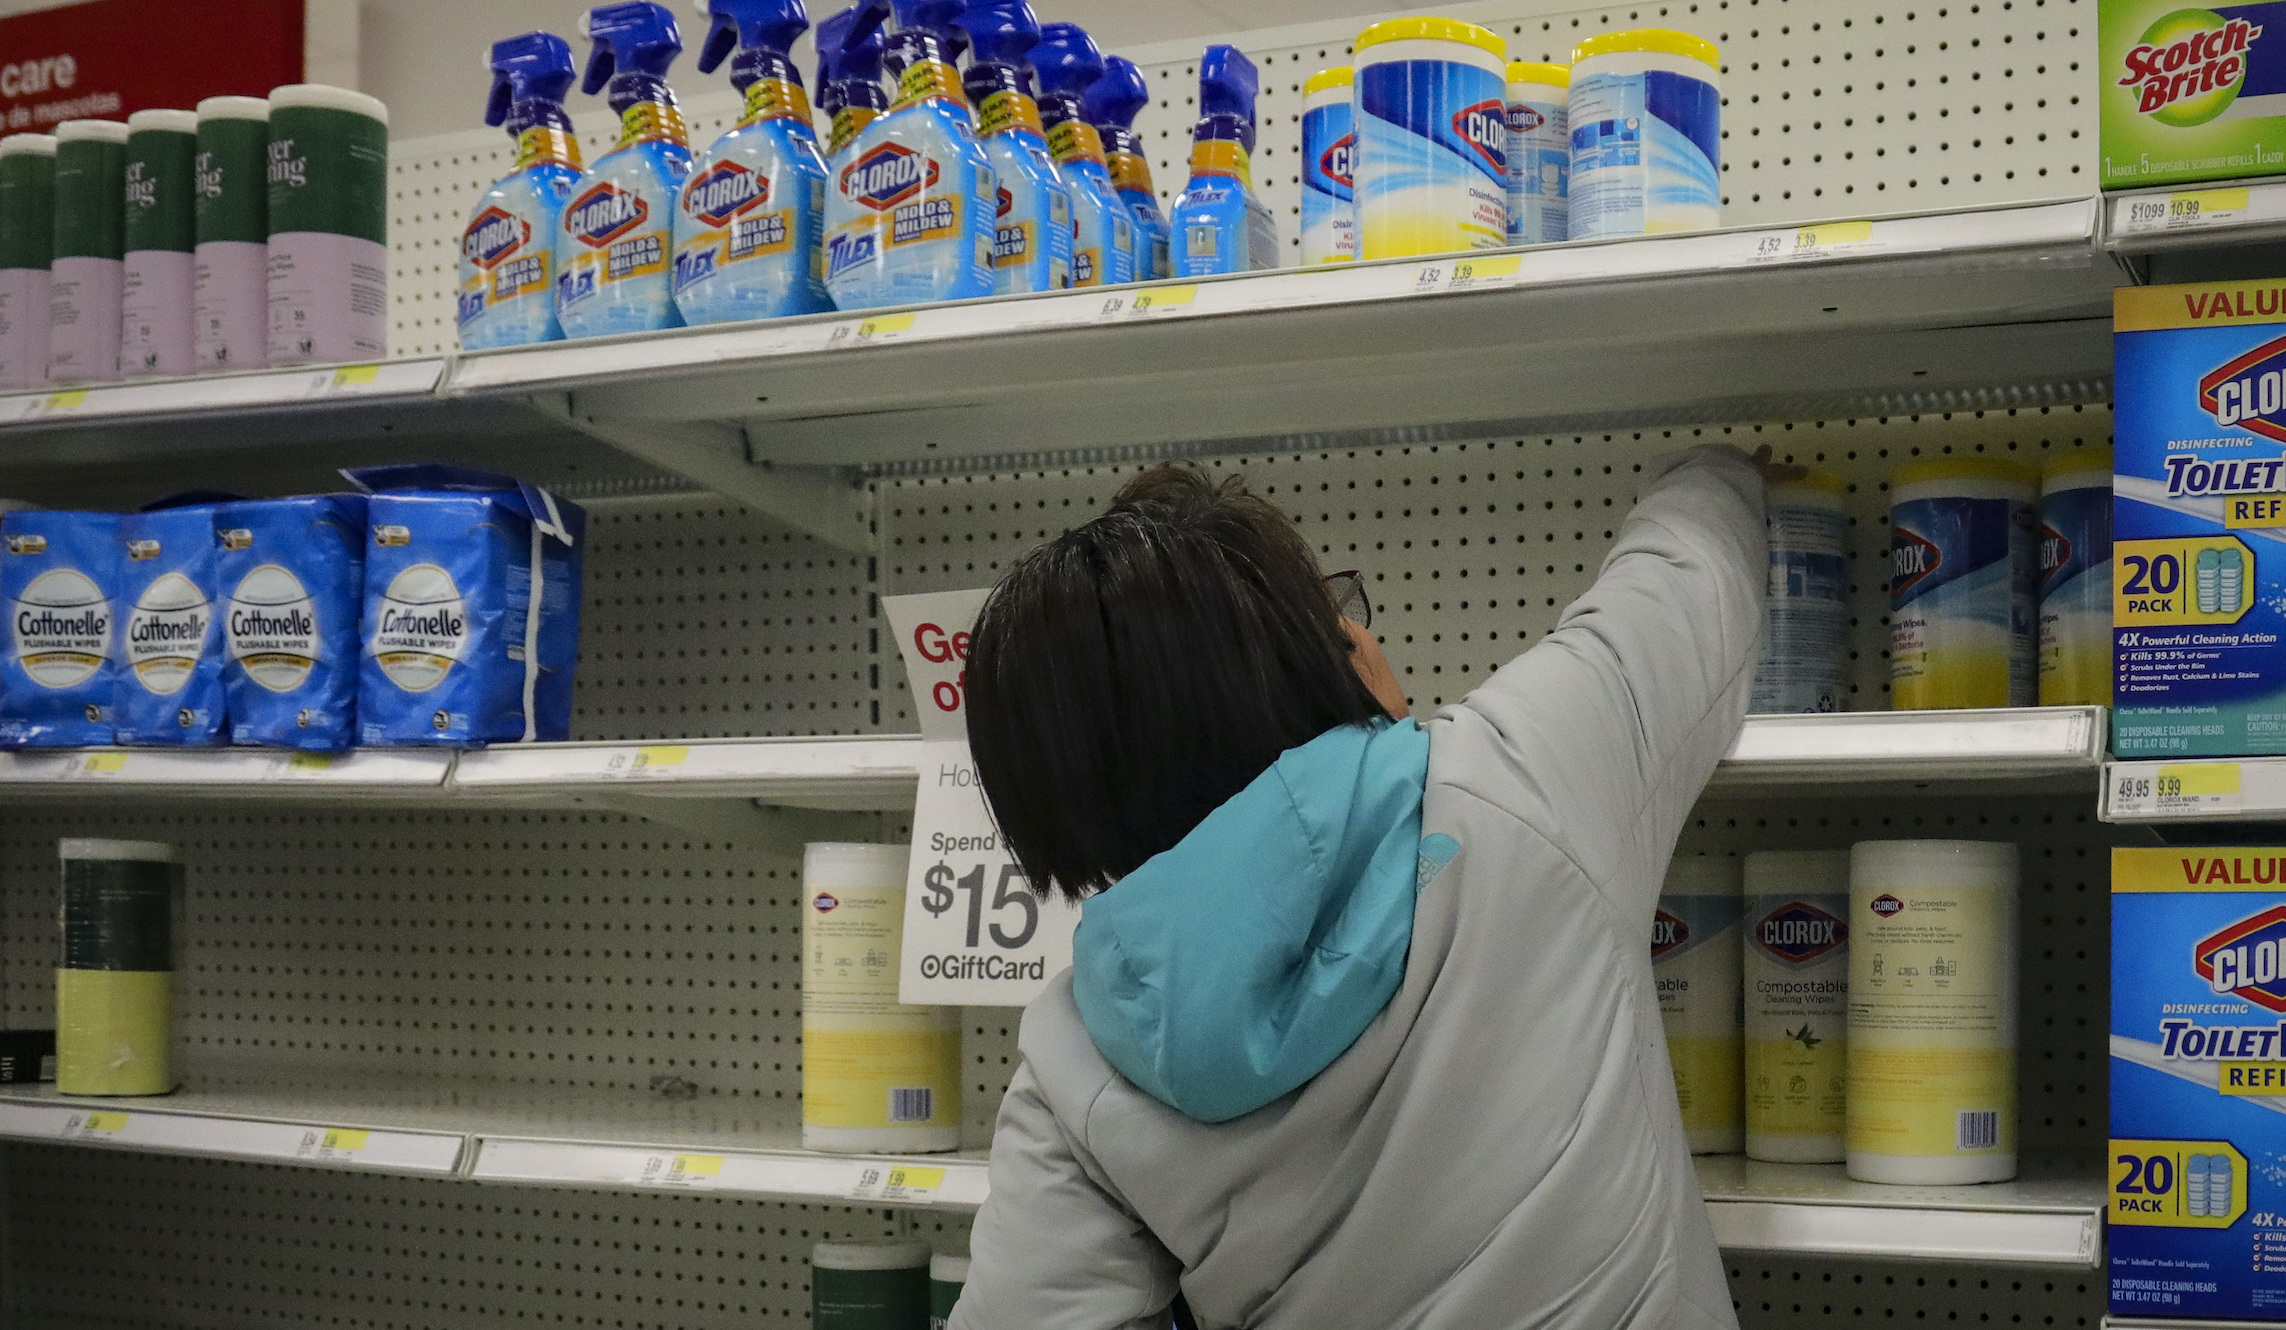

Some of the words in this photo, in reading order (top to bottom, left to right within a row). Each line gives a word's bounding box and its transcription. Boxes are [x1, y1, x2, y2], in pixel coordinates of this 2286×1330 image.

[2118, 18, 2261, 86] Scotch-
[2, 54, 77, 98] care
[2138, 56, 2242, 113] Brite
[2105, 156, 2112, 178] 1
[2112, 164, 2138, 177] HANDLE
[2141, 153, 2149, 174] 5
[2151, 160, 2190, 173] DISPOSABLE
[2192, 157, 2227, 169] SCRUBBER
[2228, 154, 2253, 166] REFILLS
[2255, 143, 2262, 165] 1
[2262, 151, 2285, 164] CADDY
[846, 153, 927, 201] CLOROX
[687, 171, 761, 219] CLOROX
[568, 189, 638, 237] CLOROX
[894, 200, 936, 221] MOLD
[936, 198, 953, 214] &
[2170, 200, 2199, 217] 10.99
[730, 219, 769, 239] MOLD
[768, 215, 783, 231] &
[894, 212, 953, 236] MILDEW
[1010, 226, 1024, 240] &
[609, 238, 645, 257] MOLD
[644, 235, 661, 252] &
[730, 227, 785, 251] MILDEW
[1794, 233, 1817, 249] 3.39
[609, 248, 661, 272] MILDEW
[1451, 265, 1473, 280] 3.39
[2184, 288, 2286, 320] VALU
[2216, 369, 2286, 427] CLO
[2167, 436, 2254, 451] DISINFECTING
[2122, 554, 2180, 596] 20
[2128, 599, 2173, 613] PACK
[19, 611, 106, 636] Cottonelle
[131, 615, 205, 642] Cottonelle
[232, 610, 312, 637] Cottonelle
[382, 609, 462, 637] Cottonelle
[2118, 633, 2141, 647] 4X
[2142, 635, 2190, 646] Powerful
[2192, 634, 2239, 646] Cleaning
[2241, 633, 2277, 643] Action
[2131, 652, 2153, 661] Kills
[2155, 651, 2185, 661] 99.9%
[2119, 727, 2128, 737] 20
[2129, 726, 2168, 737] DISPOSABLE
[2169, 725, 2202, 736] CLEANING
[2203, 725, 2225, 736] HEADS
[2119, 739, 2132, 749] NET
[2133, 739, 2143, 749] WT
[2144, 738, 2158, 748] 3.47
[2159, 738, 2168, 748] OZ
[2119, 780, 2149, 798] 49.95
[2158, 778, 2181, 797] 9.99
[931, 832, 995, 860] Spend
[921, 860, 1038, 950] $15
[1874, 900, 1900, 912] CLOROX
[1909, 900, 1957, 908] Compostable
[1764, 920, 1836, 945] CLOROX
[2213, 938, 2286, 993] CLO
[1757, 979, 1849, 995] Compostable
[2162, 1003, 2249, 1014] DISINFECTING
[2116, 1155, 2173, 1195] 20
[2119, 1198, 2163, 1212] PACK
[2252, 1213, 2275, 1227] 4X
[2112, 1291, 2125, 1300] NET
[2125, 1291, 2136, 1301] WT
[2137, 1291, 2151, 1302] 3.47
[2151, 1292, 2161, 1302] OZ
[2113, 1279, 2121, 1289] 20
[2121, 1279, 2161, 1290] DISPOSABLE
[2162, 1280, 2194, 1292] CLEANING
[2194, 1282, 2217, 1293] HEADS
